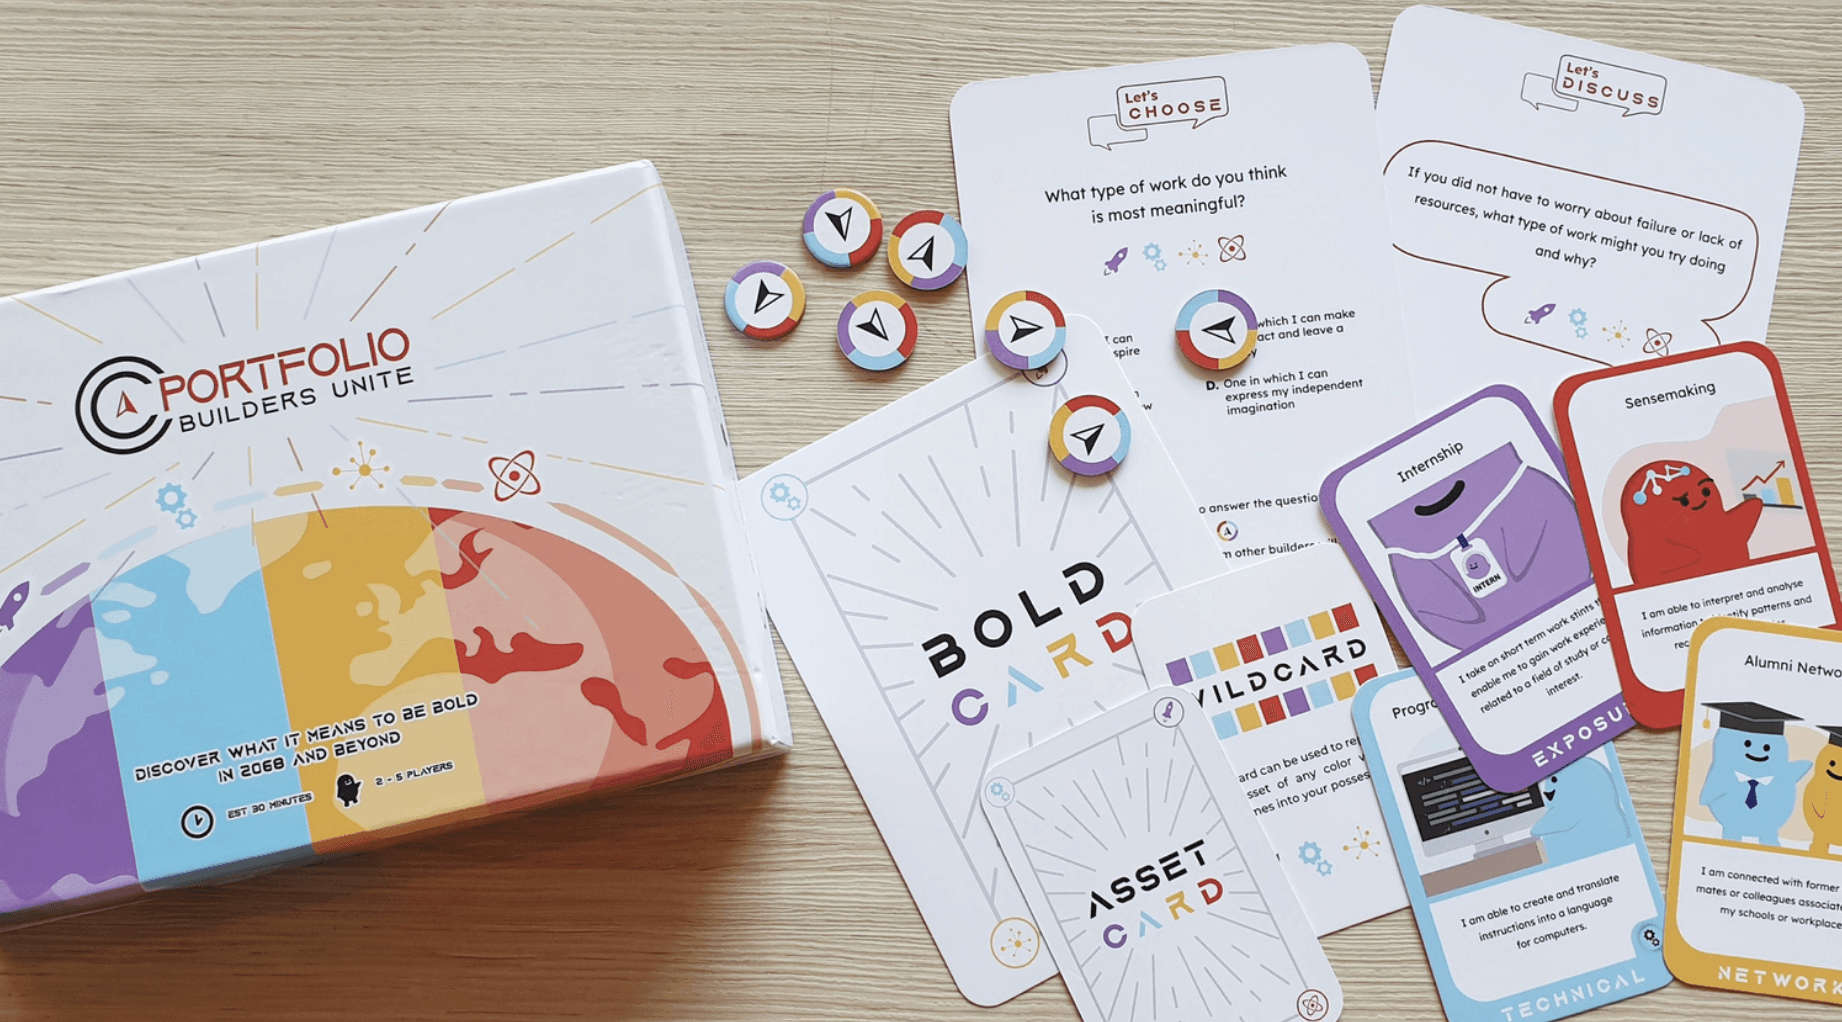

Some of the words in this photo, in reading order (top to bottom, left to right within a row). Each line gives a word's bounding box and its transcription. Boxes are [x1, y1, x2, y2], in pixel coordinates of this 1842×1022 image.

[1567, 62, 1599, 78] Let's
[1125, 90, 1158, 104] Let's
[1563, 77, 1659, 108] DISCUSS
[1129, 98, 1221, 120] CHOOSE
[1045, 188, 1086, 203] What
[1091, 183, 1125, 200] type
[1130, 180, 1145, 194] of
[1150, 176, 1187, 192] work
[1192, 174, 1211, 187] do
[1216, 170, 1244, 188] you
[1248, 165, 1287, 181] think
[1092, 210, 1103, 224] is
[1108, 206, 1145, 222] most
[1150, 194, 1245, 217] meaningful?
[1408, 166, 1420, 178] If
[1424, 169, 1447, 184] you
[1451, 175, 1472, 189] did
[1476, 181, 1497, 195] not
[1502, 186, 1532, 203] have
[1537, 195, 1549, 207] to
[1554, 199, 1590, 218] worry
[1594, 206, 1632, 225] about
[1637, 216, 1676, 235] failure
[1681, 228, 1695, 239] or
[1699, 230, 1724, 247] lack
[1729, 237, 1743, 250] of
[1415, 194, 1479, 219] resources,
[1483, 209, 1514, 225] what
[1518, 216, 1546, 233] type
[1550, 221, 1563, 235] of
[1567, 225, 1597, 242] work
[1601, 232, 1637, 253] might
[1641, 244, 1665, 260] you
[1668, 251, 1686, 265] try
[1689, 252, 1725, 274] doing
[1535, 246, 1559, 260] and
[1564, 252, 1597, 268] why?
[1300, 313, 1321, 323] can
[1324, 310, 1355, 320] make
[1113, 334, 1133, 344] can
[1282, 329, 1300, 339] and
[1303, 325, 1333, 336] leave
[159, 327, 410, 412] PORTFOLIO
[1206, 381, 1219, 390] D.
[1224, 378, 1246, 388] One
[1250, 376, 1260, 385] in
[1263, 371, 1296, 384] which
[1307, 369, 1328, 379] can
[179, 388, 316, 433] BUILDERS
[332, 366, 414, 398] UNITE
[1226, 389, 1268, 402] express
[1272, 387, 1289, 399] my
[1292, 378, 1362, 395] independent
[1625, 383, 1717, 409] Sensemaking
[1227, 400, 1295, 416] imagination
[1397, 442, 1464, 483] Internship
[1209, 501, 1250, 513] answer
[1254, 499, 1272, 508] the
[1235, 547, 1265, 558] other
[1473, 573, 1501, 593] INTERN
[1642, 612, 1647, 620] I
[1649, 611, 1665, 619] am
[1667, 605, 1688, 615] able
[1690, 601, 1700, 610] to
[1702, 592, 1743, 608] interpret
[1746, 587, 1764, 597] and
[1766, 578, 1803, 595] analyse
[921, 561, 1104, 678] BOLD
[1641, 619, 1697, 638] information
[1751, 601, 1791, 616] patterns
[1793, 596, 1812, 606] and
[1458, 675, 1465, 684] I
[1466, 664, 1486, 680] take
[1488, 657, 1500, 668] on
[1501, 643, 1524, 661] short
[1525, 631, 1547, 647] term
[1547, 616, 1568, 633] work
[1570, 603, 1594, 621] stints
[952, 612, 1133, 726] CARD
[1471, 677, 1501, 698] enable
[1502, 669, 1517, 681] me
[1517, 662, 1528, 672] to
[1529, 649, 1549, 667] gain
[1549, 637, 1572, 653] work
[1745, 655, 1792, 672] Alumni
[1480, 690, 1513, 714] related
[1513, 683, 1523, 694] to
[1532, 667, 1553, 684] field
[1553, 661, 1564, 672] of
[1565, 648, 1590, 666] study
[1545, 672, 1583, 697] interest.
[135, 751, 220, 782] DISCOVER
[228, 738, 277, 759] WHAT
[284, 733, 301, 748] IT
[306, 719, 366, 742] MEANS
[372, 712, 396, 727] TO
[402, 705, 426, 721] BE
[432, 693, 478, 714] BOLD
[1532, 702, 1626, 767] EXPOSU
[218, 769, 234, 783] IN
[240, 758, 284, 778] 2068
[293, 748, 327, 766] AND
[334, 731, 401, 755] BEYOND
[1260, 762, 1281, 776] can
[1283, 756, 1298, 768] be
[1300, 745, 1329, 762] used
[1330, 742, 1343, 753] to
[375, 777, 383, 786] 2
[395, 774, 403, 782] 5
[407, 762, 453, 779] PLAYERS
[1277, 777, 1289, 788] of
[1295, 769, 1317, 784] any
[1323, 757, 1352, 774] color
[228, 808, 247, 819] EST
[252, 803, 265, 813] 30
[269, 793, 312, 809] MINUTES
[1276, 793, 1300, 809] into
[1302, 785, 1328, 801] your
[1090, 839, 1205, 919] ASSET
[1701, 867, 1705, 875] I
[1709, 869, 1724, 877] am
[1728, 871, 1779, 884] connected
[1782, 878, 1803, 887] with
[1806, 880, 1839, 892] former
[1461, 918, 1467, 927] I
[1469, 915, 1485, 925] am
[1487, 907, 1509, 920] able
[1510, 904, 1521, 913] to
[1523, 895, 1554, 910] create
[1556, 887, 1575, 900] and
[1576, 874, 1620, 893] translate
[1696, 885, 1727, 896] mates
[1729, 889, 1740, 897] or
[1743, 890, 1795, 905] colleagues
[1103, 878, 1223, 949] CARD
[1479, 919, 1535, 942] instructions
[1537, 911, 1557, 924] into
[1567, 895, 1613, 915] language
[1720, 907, 1735, 916] my
[1738, 908, 1775, 920] schools
[1516, 939, 1531, 949] for
[1533, 923, 1587, 945] computers.
[1501, 969, 1645, 1022] TECHNICAL
